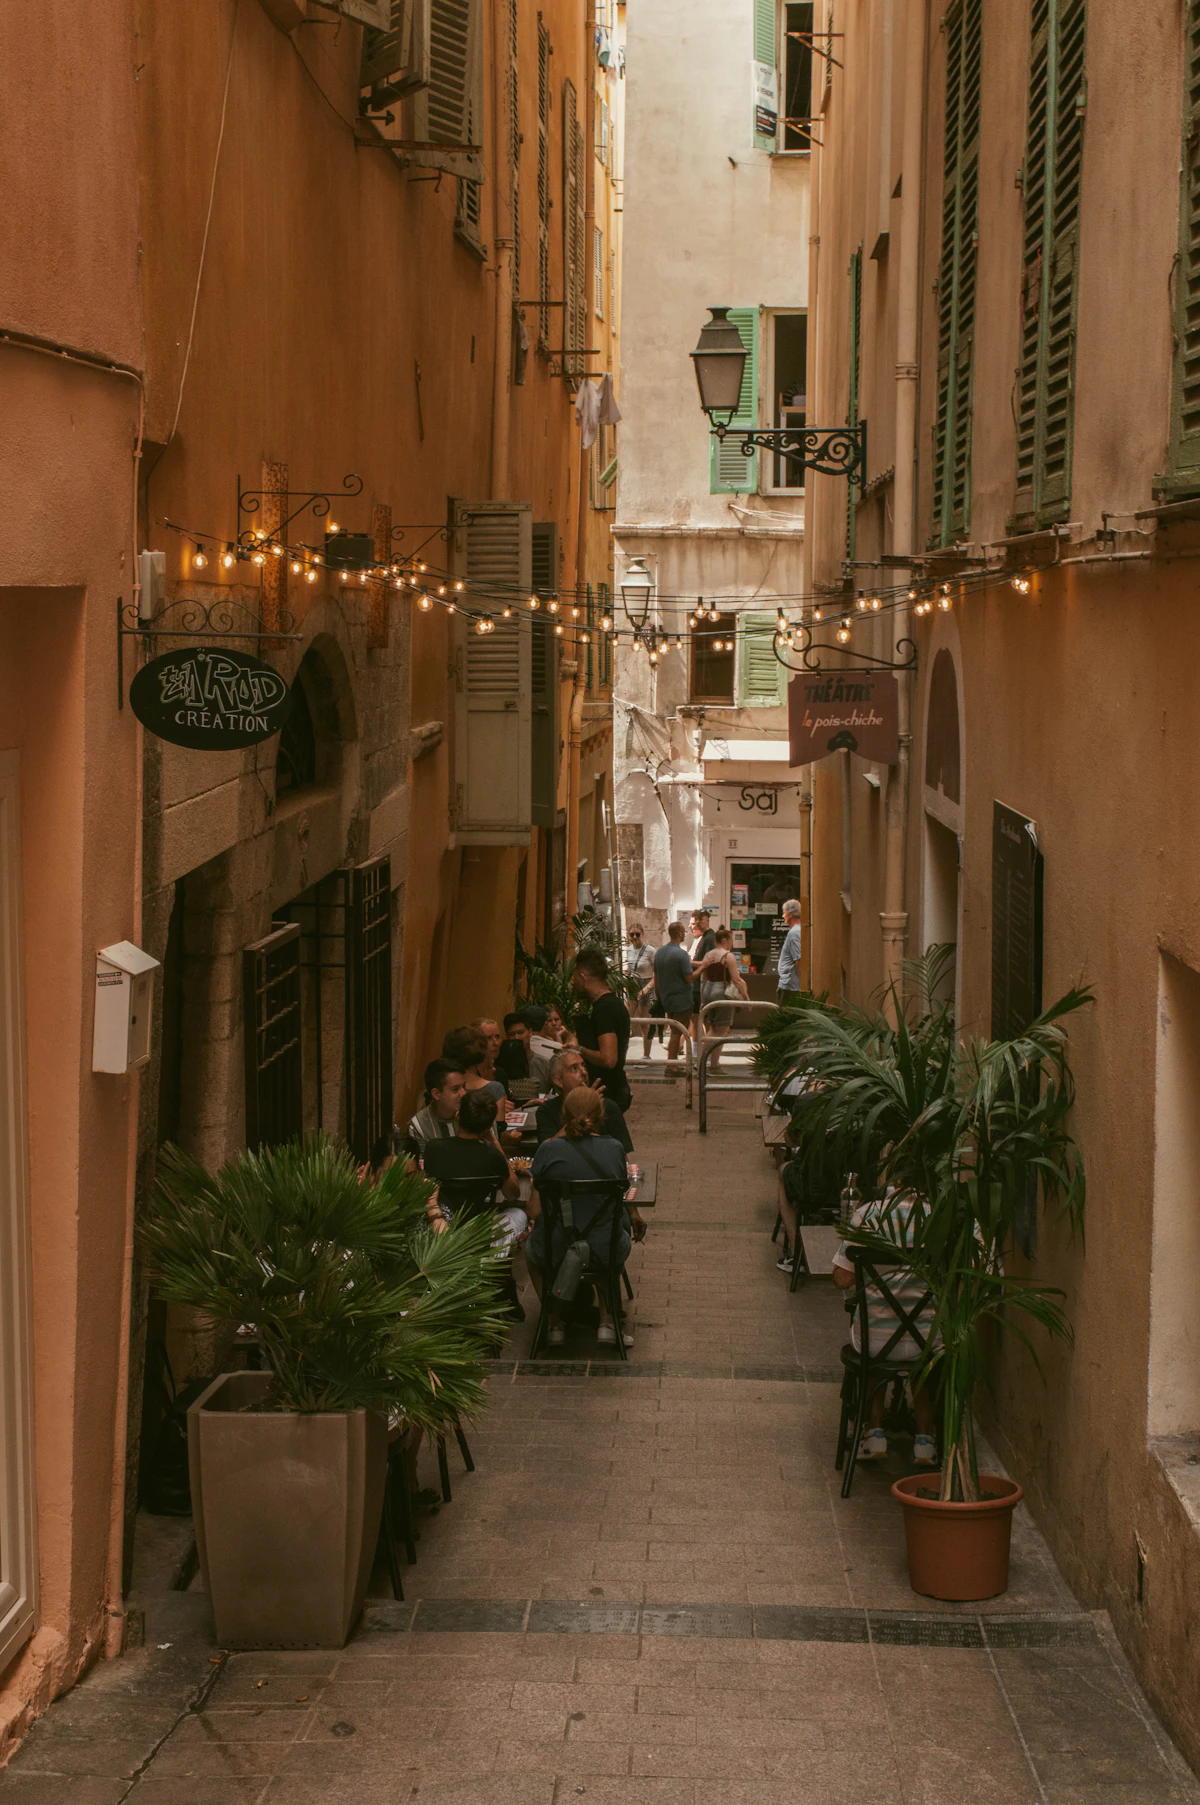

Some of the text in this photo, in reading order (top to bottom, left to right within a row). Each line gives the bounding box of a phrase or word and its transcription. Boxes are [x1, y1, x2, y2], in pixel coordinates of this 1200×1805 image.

[804, 677, 875, 703] THÉÂTRE
[174, 706, 269, 732] CRÉATION
[802, 708, 884, 738] le pois-chiche
[738, 786, 778, 815] Saj
